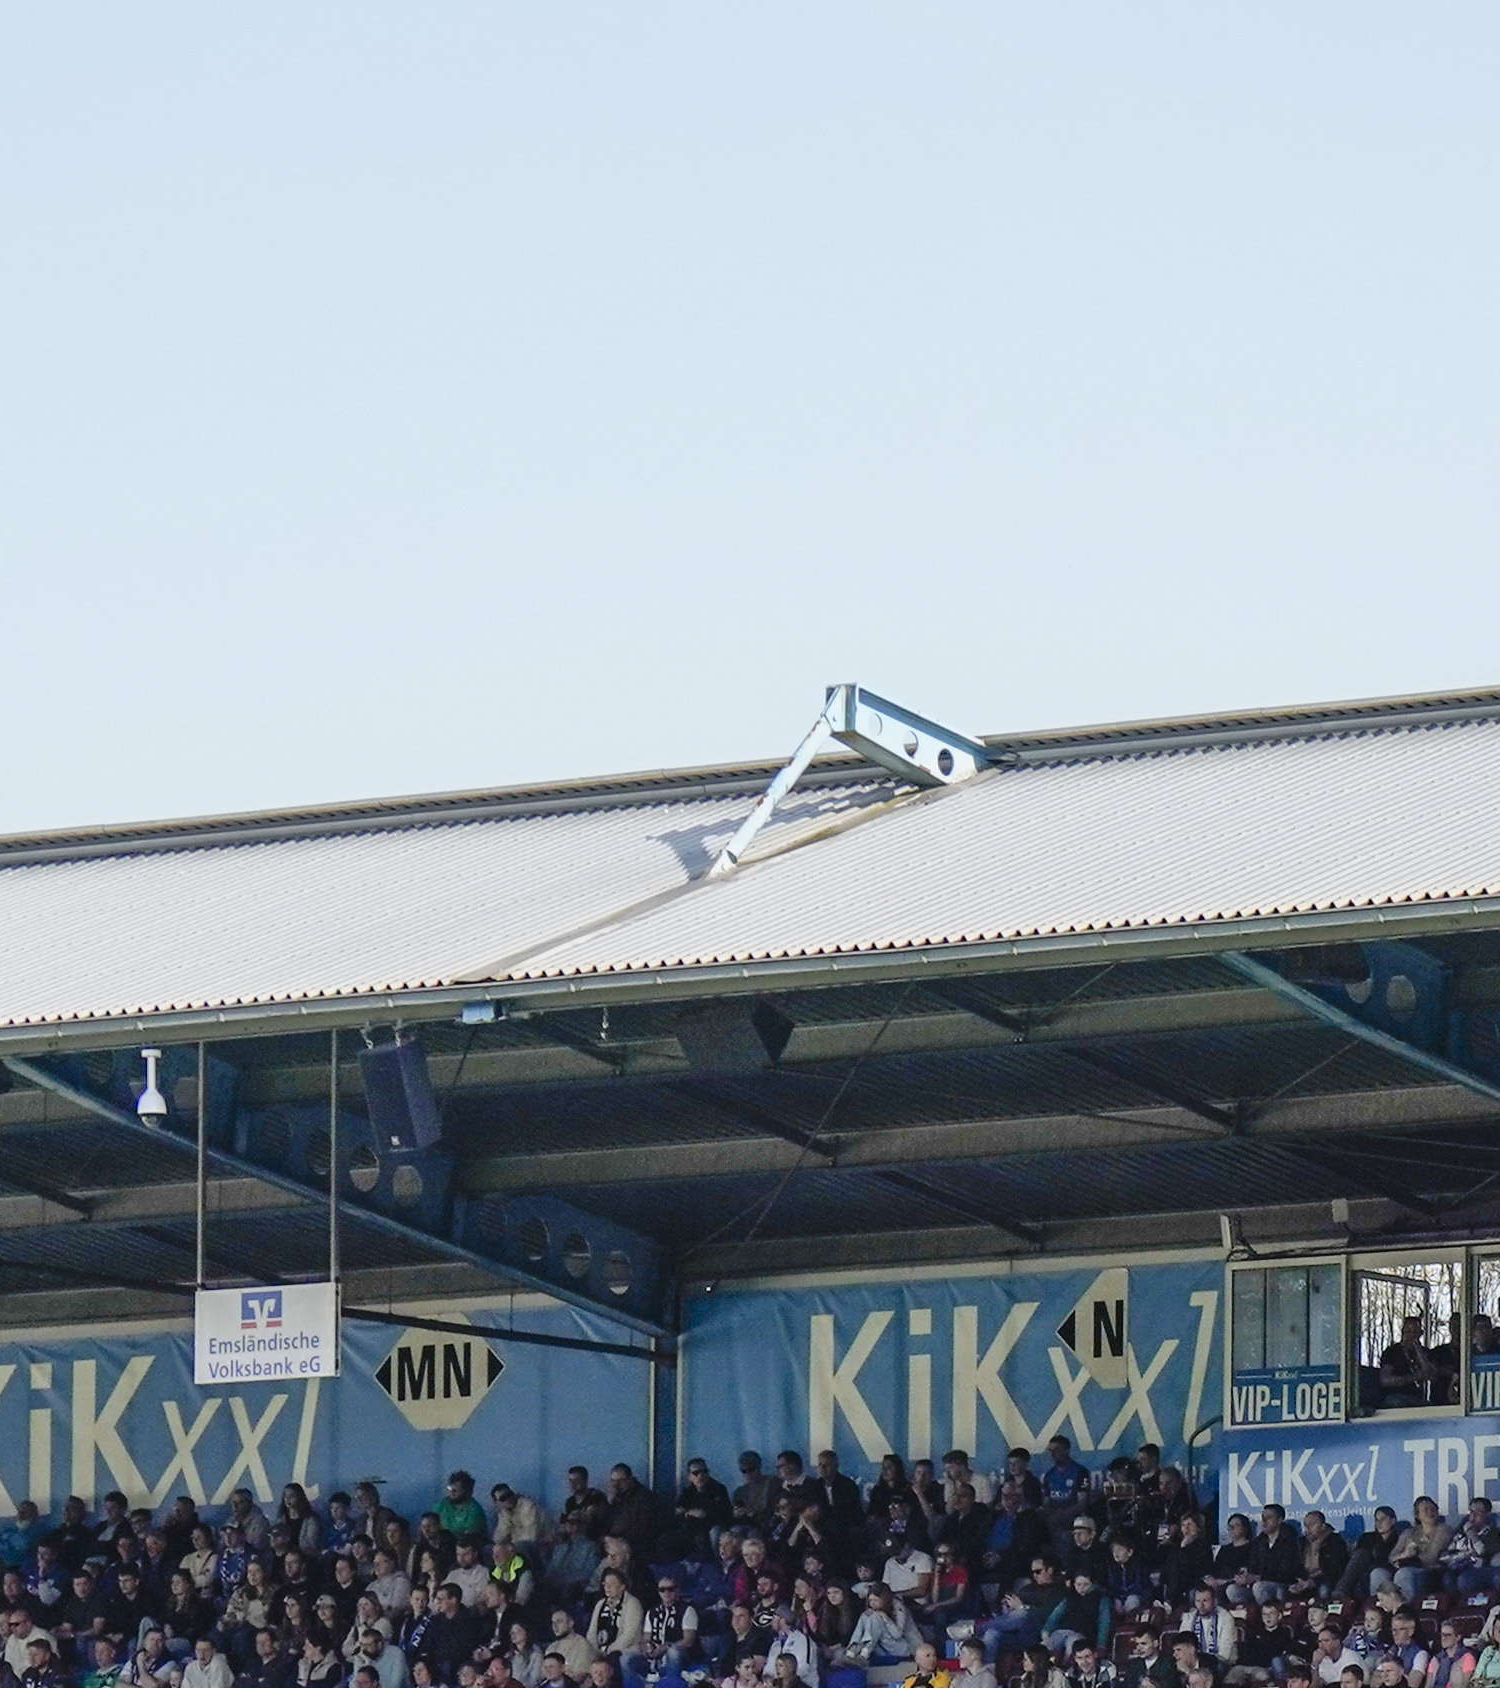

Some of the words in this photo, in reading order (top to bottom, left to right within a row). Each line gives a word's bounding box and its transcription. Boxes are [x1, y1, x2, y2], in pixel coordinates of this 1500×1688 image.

[208, 1331, 321, 1355] Emsländische
[1092, 1300, 1124, 1358] N
[208, 1356, 294, 1379] Volksbank
[300, 1356, 321, 1373] eG
[397, 1342, 473, 1401] MN
[1232, 1382, 1342, 1423] VIP-LOGE
[1228, 1445, 1379, 1510] KiKxxl
